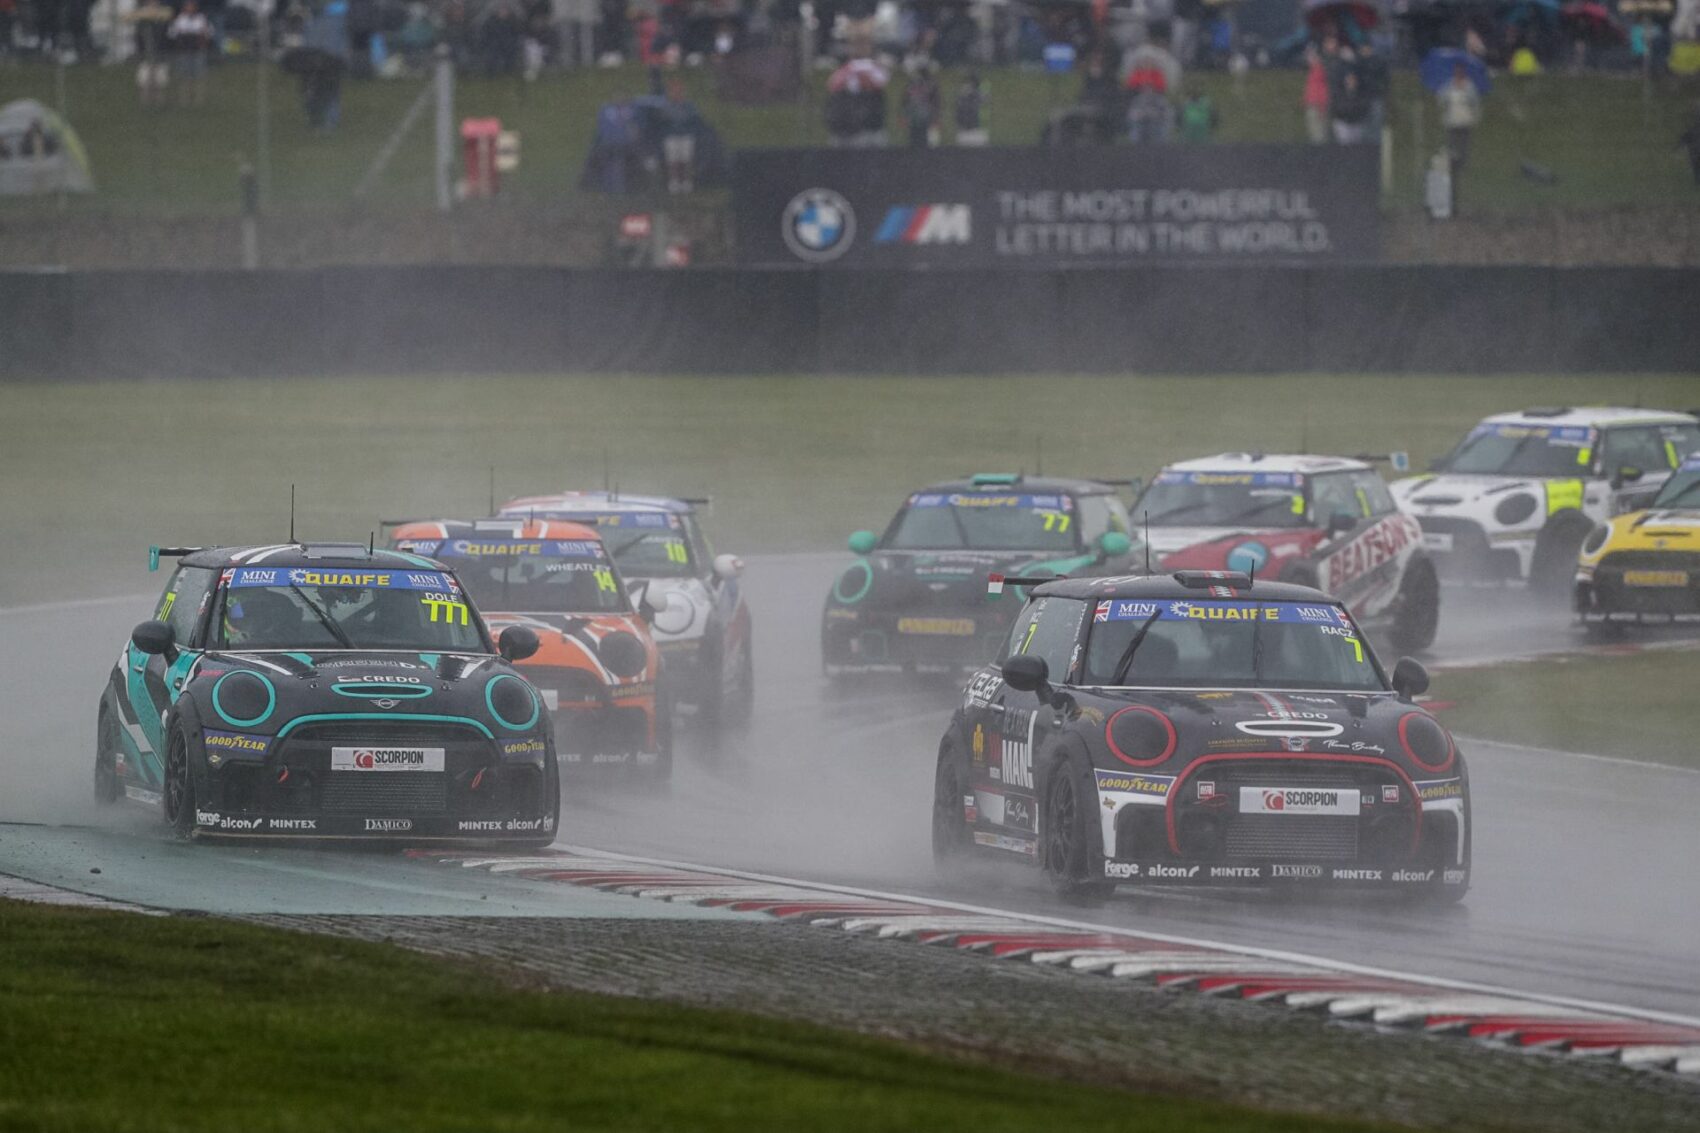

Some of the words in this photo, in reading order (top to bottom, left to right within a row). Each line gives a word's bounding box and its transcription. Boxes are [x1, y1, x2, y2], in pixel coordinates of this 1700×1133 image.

[1000, 190, 1057, 220] THE
[1062, 190, 1151, 220] MOST
[1152, 190, 1317, 220] POWERFUL
[996, 223, 1111, 254] LETTER
[1114, 223, 1149, 254] IN
[1151, 223, 1210, 254] THE
[1214, 222, 1332, 254] WORLD.
[1040, 513, 1070, 532] 77
[466, 543, 541, 556] QUAIFE
[665, 542, 687, 564] 10
[241, 570, 277, 580] MINI
[304, 573, 391, 586] QUAIFE
[406, 574, 440, 585] MINI
[592, 570, 617, 594] 14
[424, 592, 459, 604] DOLE
[420, 599, 469, 627] 777
[1119, 603, 1157, 613] MINI
[1188, 607, 1279, 620] QUAIFE
[1295, 607, 1329, 619] MINI
[1319, 626, 1354, 639] RACZ
[1342, 637, 1363, 664] 7
[352, 675, 420, 684] CREDO
[1266, 711, 1329, 720] CREDO
[205, 736, 266, 752] GOODYEAR
[375, 750, 424, 764] SCORPION
[1099, 778, 1168, 793] GOODYEAR
[1285, 791, 1338, 806] SCORPION
[220, 816, 252, 829] alcon
[269, 819, 317, 829] MINTEX
[458, 821, 502, 831] MINTEX
[507, 818, 533, 831] alcon
[1148, 864, 1188, 878] alcon
[1210, 867, 1261, 878] MINTEX
[1332, 869, 1383, 881] MINTEX
[1391, 869, 1426, 882] alcon
